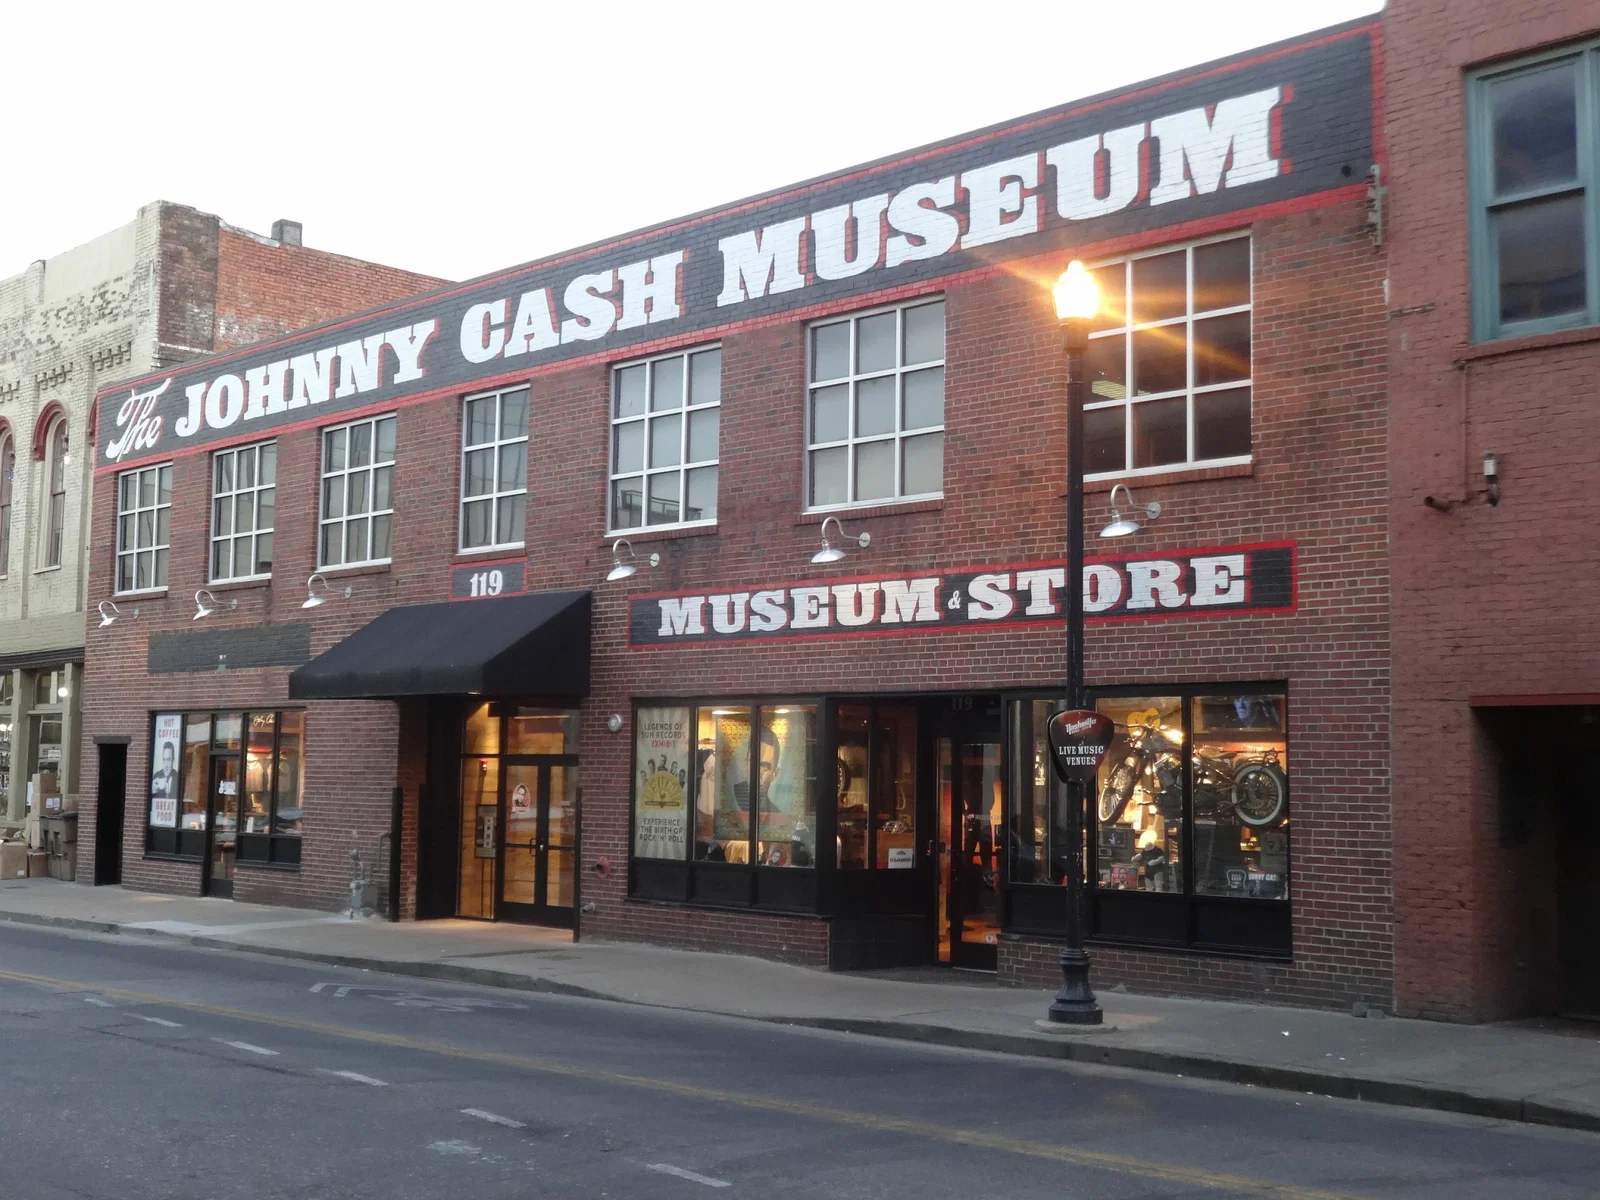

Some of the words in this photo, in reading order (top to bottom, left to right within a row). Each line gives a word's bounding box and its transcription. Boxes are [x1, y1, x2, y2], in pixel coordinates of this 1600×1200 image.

[105, 378, 172, 462] The
[175, 319, 437, 437] JOHNNY
[460, 250, 685, 364] CASH
[717, 86, 1282, 307] MUSEUM
[470, 570, 503, 597] 119
[657, 577, 940, 637] MUSEUM
[947, 590, 961, 610] &
[967, 554, 1245, 620] STORE
[952, 696, 973, 711] 119
[644, 722, 673, 731] LEGENDS
[674, 722, 684, 731] OF
[158, 728, 179, 739] COFFEE
[641, 731, 654, 739] SUN
[656, 731, 686, 739] RECORDS
[651, 739, 677, 748] EXHIBIT
[1059, 746, 1077, 755] LIVE
[1078, 745, 1104, 755] MUSIC
[1066, 756, 1096, 766] VENUES
[156, 801, 175, 811] GREAT
[643, 818, 681, 827] EXPERIENCE
[641, 825, 653, 834] THE
[654, 826, 672, 835] BIRTH
[673, 827, 683, 835] OF
[639, 833, 656, 842] ROCK
[668, 835, 684, 844] ROLL
